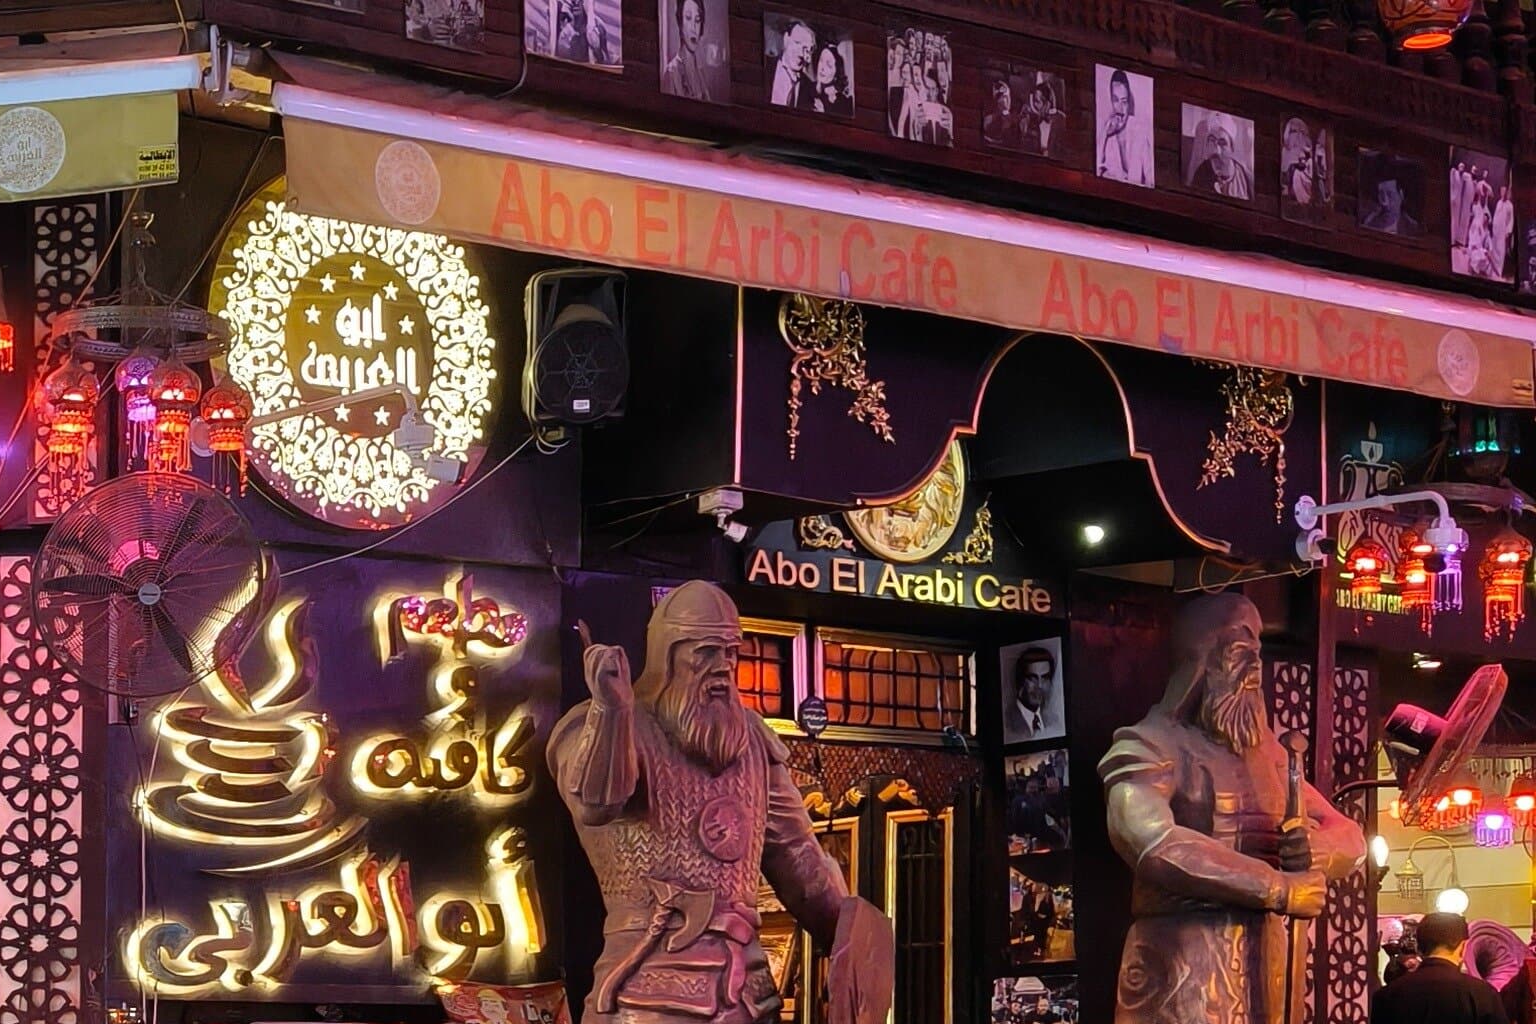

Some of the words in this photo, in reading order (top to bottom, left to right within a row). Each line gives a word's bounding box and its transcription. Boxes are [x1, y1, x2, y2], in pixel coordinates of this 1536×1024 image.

[490, 160, 615, 254] Abo
[635, 183, 687, 266] El
[704, 198, 821, 287] Arbi
[839, 220, 958, 309] Cafe
[1039, 257, 1140, 341] Abo
[1156, 277, 1197, 352] El
[1211, 287, 1300, 367] Arbi
[1314, 306, 1409, 385] Cafe
[747, 549, 821, 589] Abo
[832, 557, 865, 594] El
[876, 563, 964, 606] Arabi
[974, 573, 1052, 614] Cafe
[1387, 594, 1410, 615] CAF
